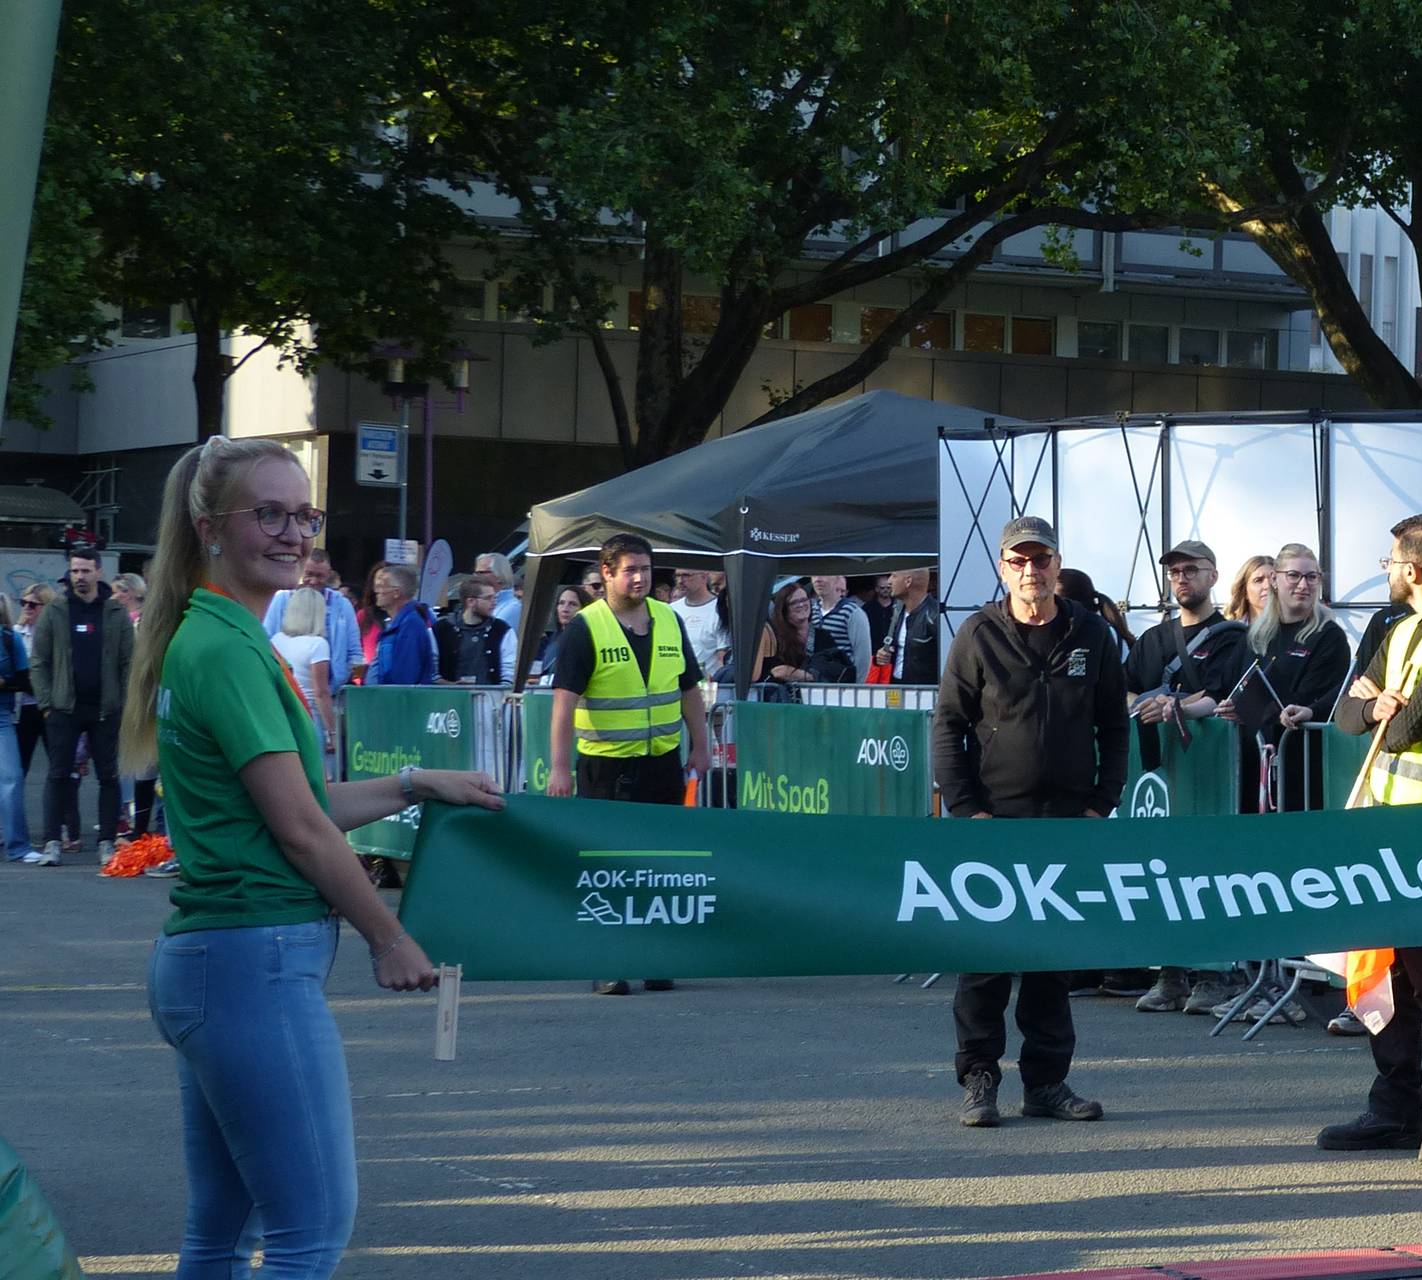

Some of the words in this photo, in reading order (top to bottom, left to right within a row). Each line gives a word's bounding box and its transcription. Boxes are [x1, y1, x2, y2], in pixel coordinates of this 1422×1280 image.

[600, 646, 630, 663] 1119
[426, 711, 447, 734] AOK
[856, 738, 890, 767] AOK
[741, 770, 776, 810] Mit
[776, 774, 830, 815] Spaß
[576, 869, 716, 889] AOK-Firmen-
[625, 895, 717, 925] LAUF
